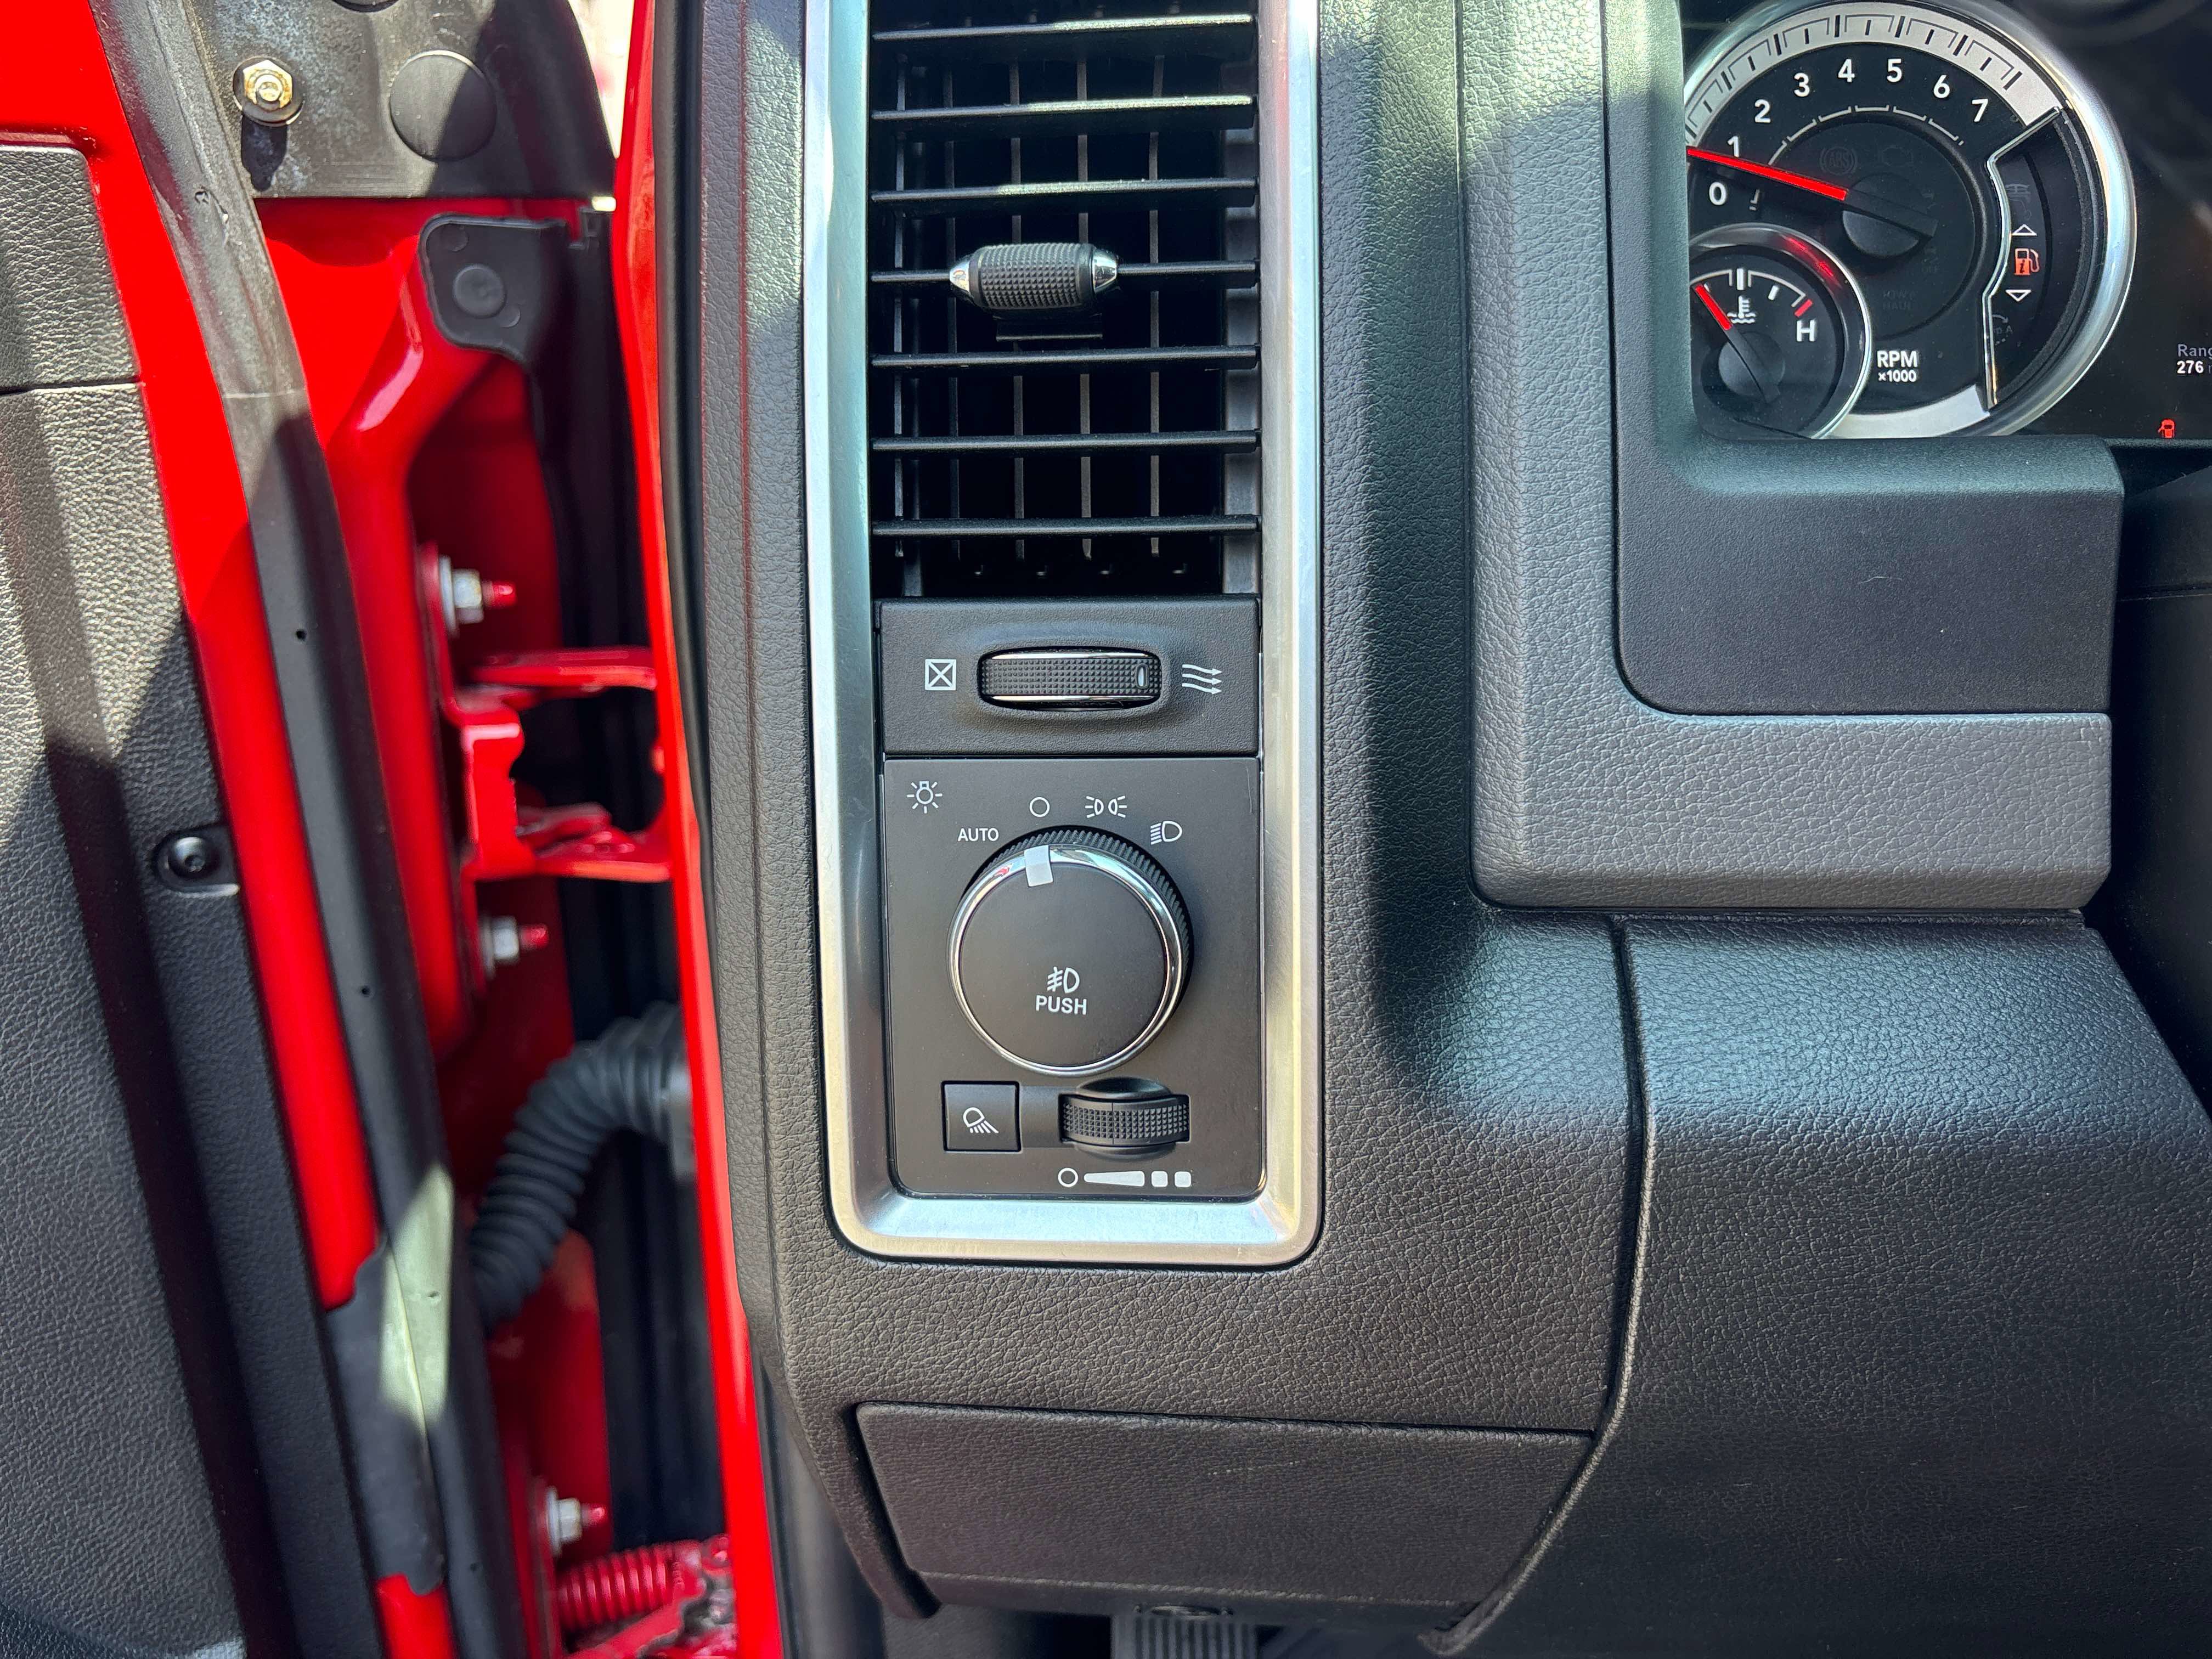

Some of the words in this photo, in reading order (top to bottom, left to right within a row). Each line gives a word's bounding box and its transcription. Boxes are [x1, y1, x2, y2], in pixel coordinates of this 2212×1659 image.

[1837, 59, 1855, 82] 4
[1887, 58, 1902, 82] 5
[1793, 72, 1810, 97] 3
[1933, 75, 1950, 98] 6
[1754, 99, 1771, 123] 2
[1972, 98, 1988, 122] 7
[1728, 136, 1739, 157] 1
[1708, 182, 1726, 206] 0
[1796, 319, 1816, 342] H
[1876, 350, 1918, 368] RPM
[2176, 360, 2204, 374] 276
[957, 827, 999, 842] AUTO
[1035, 995, 1087, 1015] PUSH
